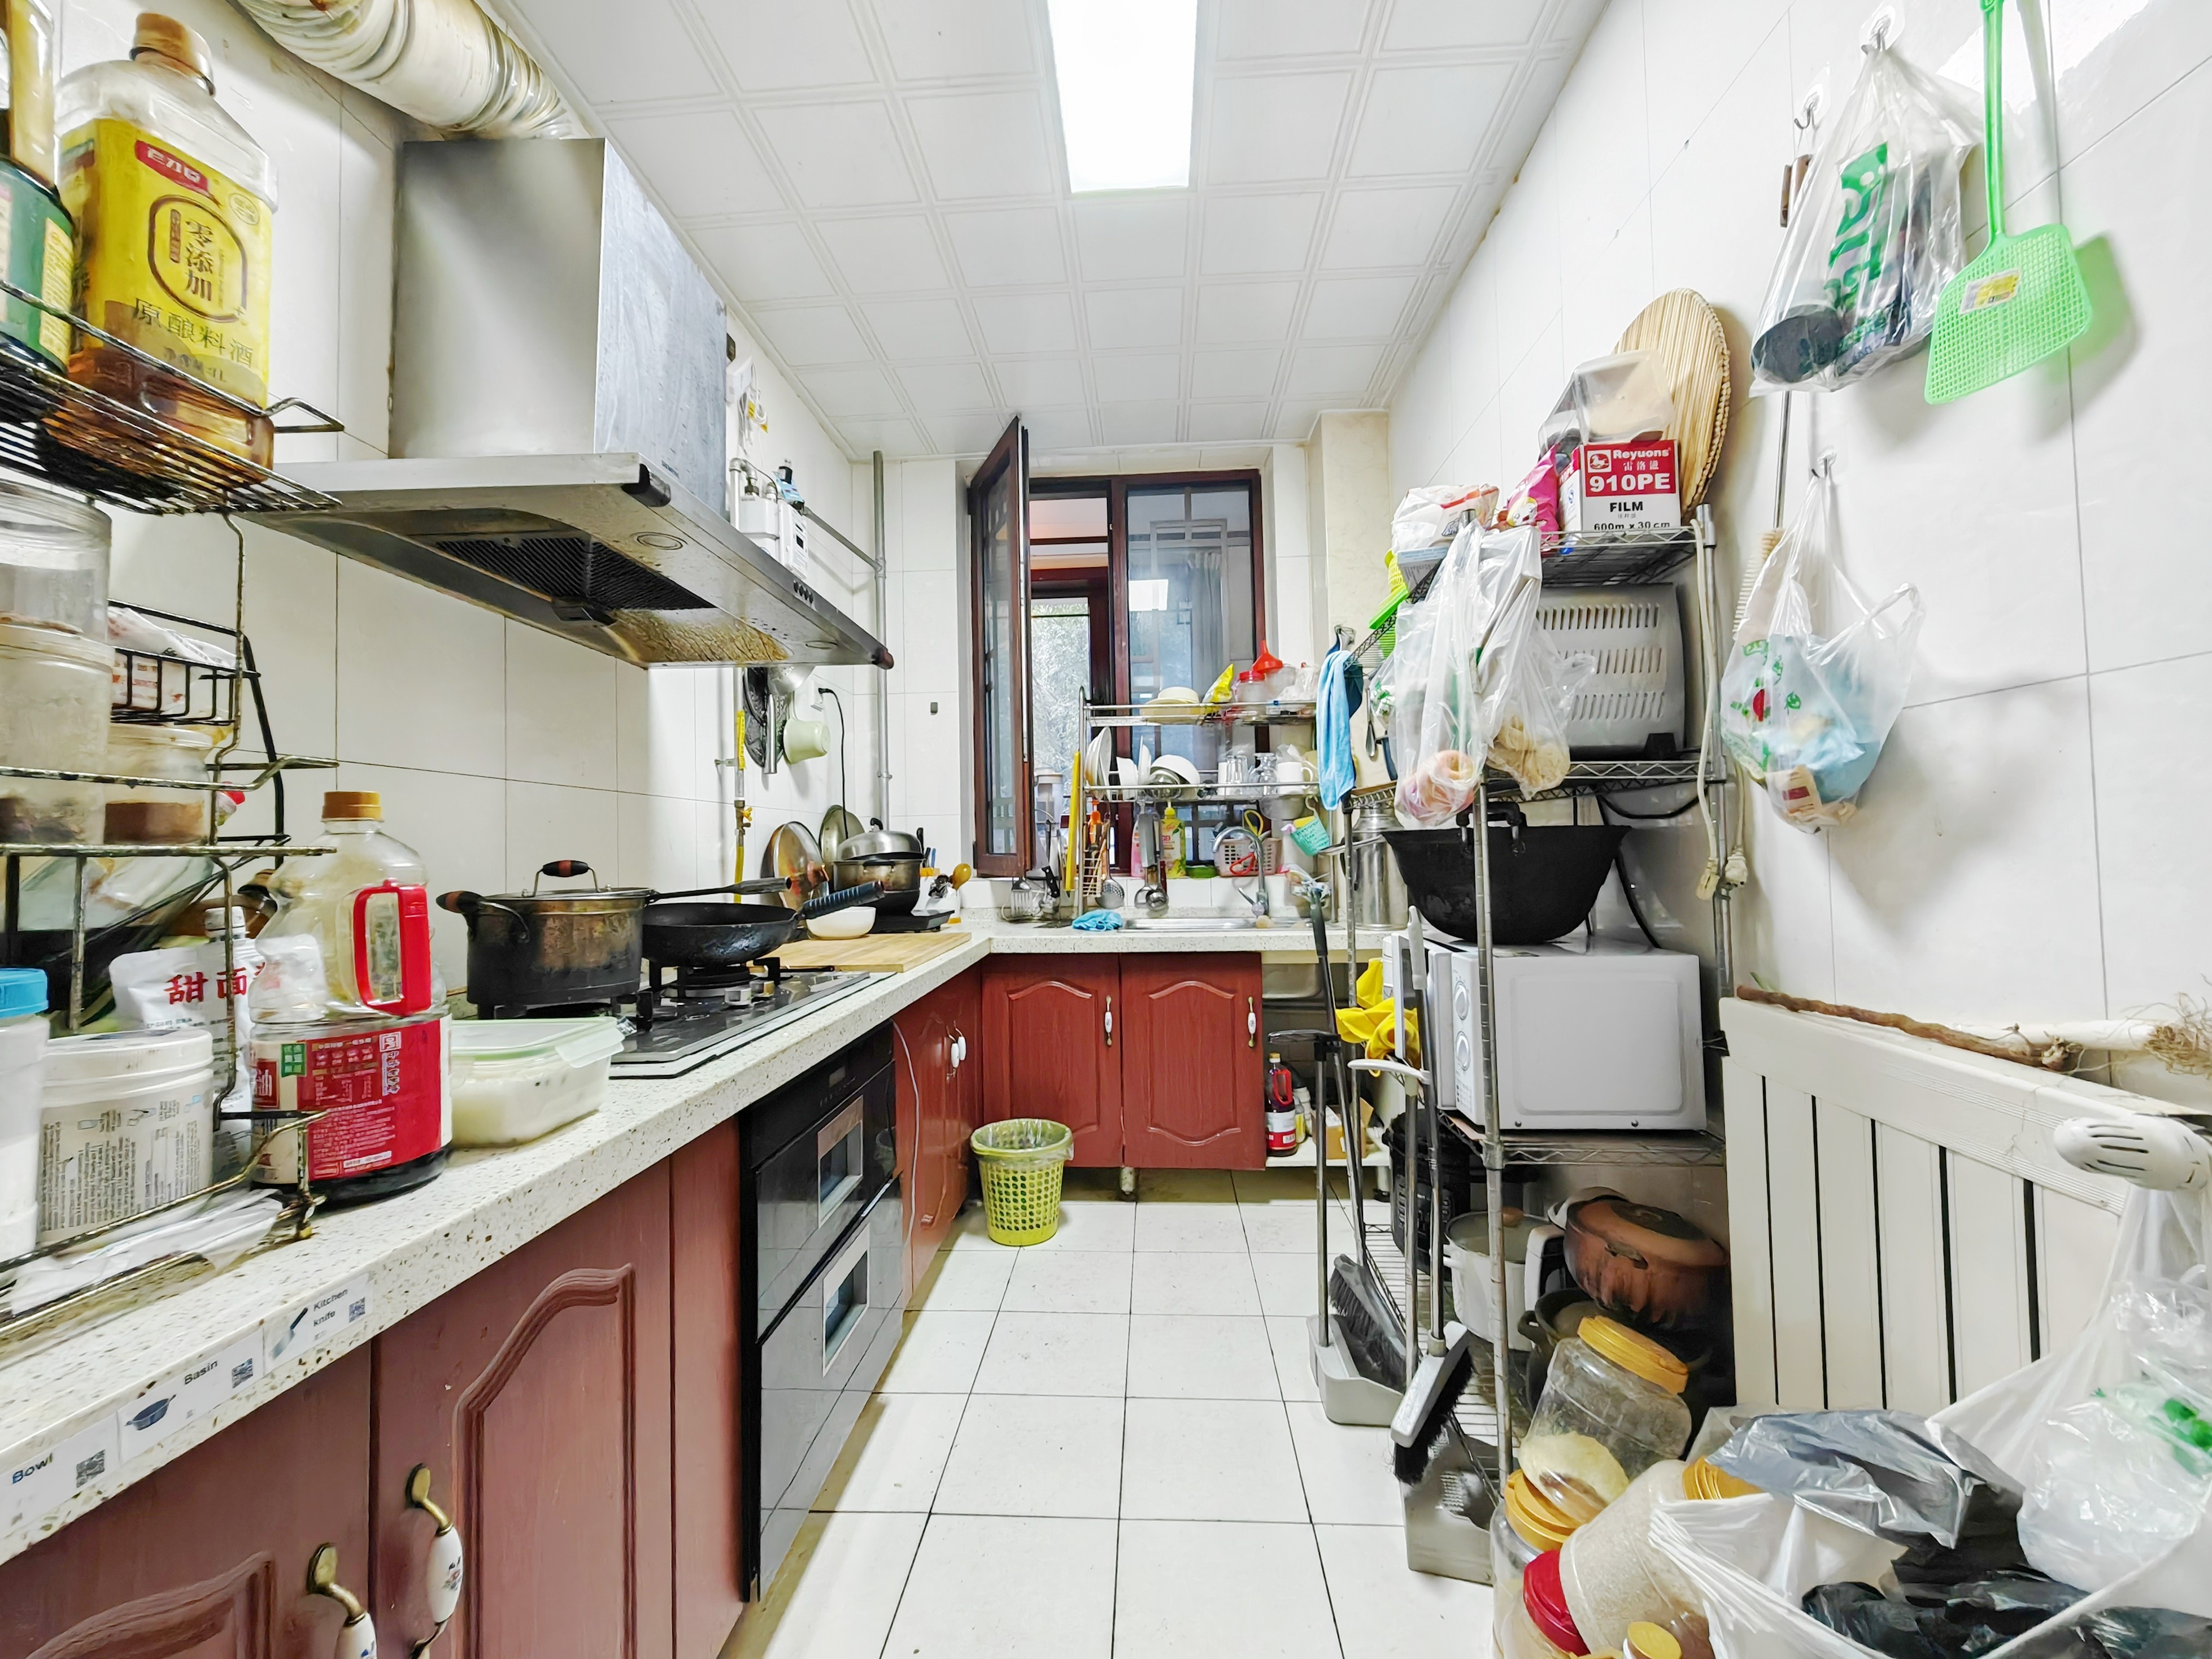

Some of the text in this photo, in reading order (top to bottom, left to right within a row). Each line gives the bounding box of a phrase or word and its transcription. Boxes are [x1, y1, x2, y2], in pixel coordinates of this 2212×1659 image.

[185, 219, 214, 302] 零添加
[133, 298, 252, 368] 原酿料酒
[1613, 449, 1669, 460] Reyuons
[1589, 473, 1671, 493] 910PE
[1609, 501, 1644, 513] FILM
[1638, 521, 1651, 529] 30
[313, 1289, 349, 1312] Kitchen
[313, 1310, 336, 1327] knife
[184, 1360, 219, 1386] Basin
[11, 1452, 54, 1485] Bowl
